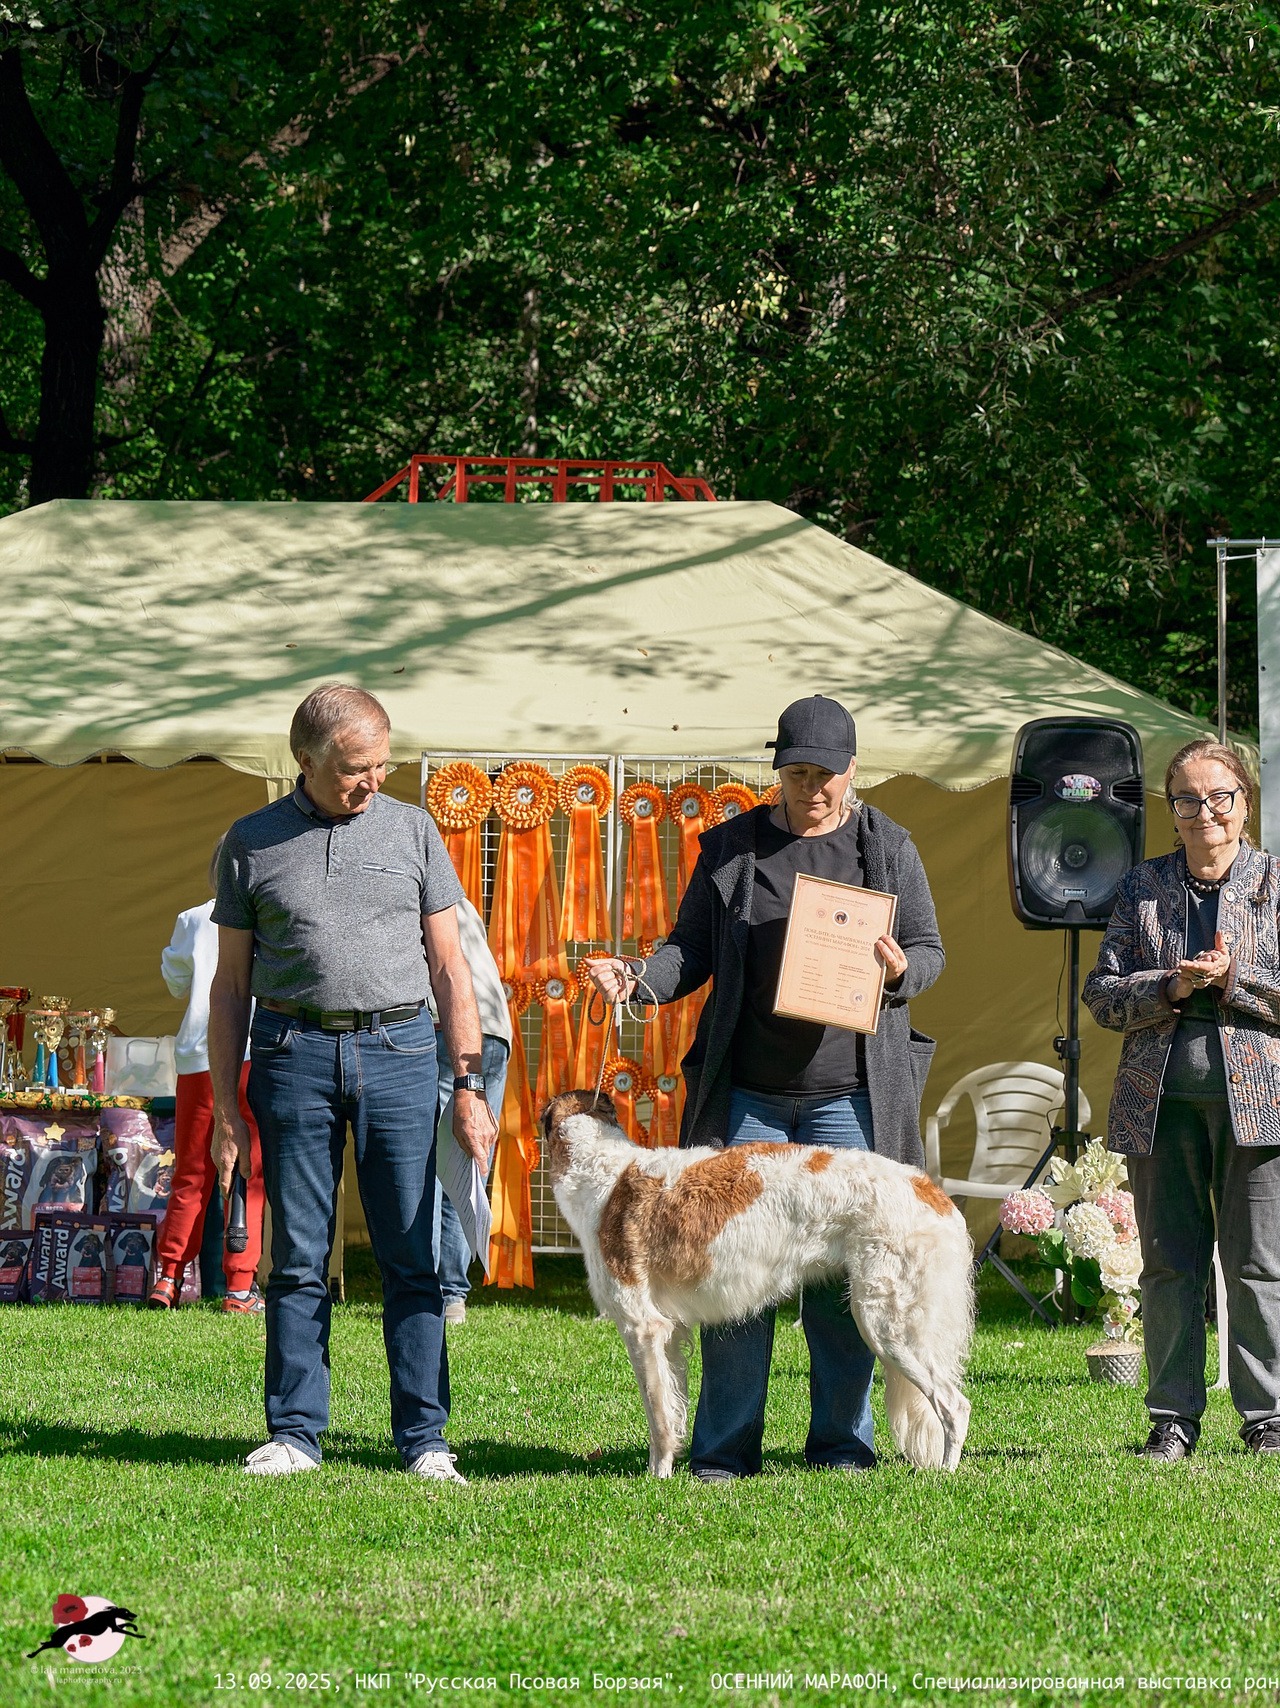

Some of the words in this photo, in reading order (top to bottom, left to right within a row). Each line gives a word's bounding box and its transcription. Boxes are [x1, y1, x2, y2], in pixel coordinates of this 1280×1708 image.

[1062, 788, 1093, 797] SPEAKER
[0, 1148, 27, 1231] Award
[108, 1147, 129, 1213] ward
[36, 1227, 53, 1283] Award
[51, 1228, 70, 1290] Award
